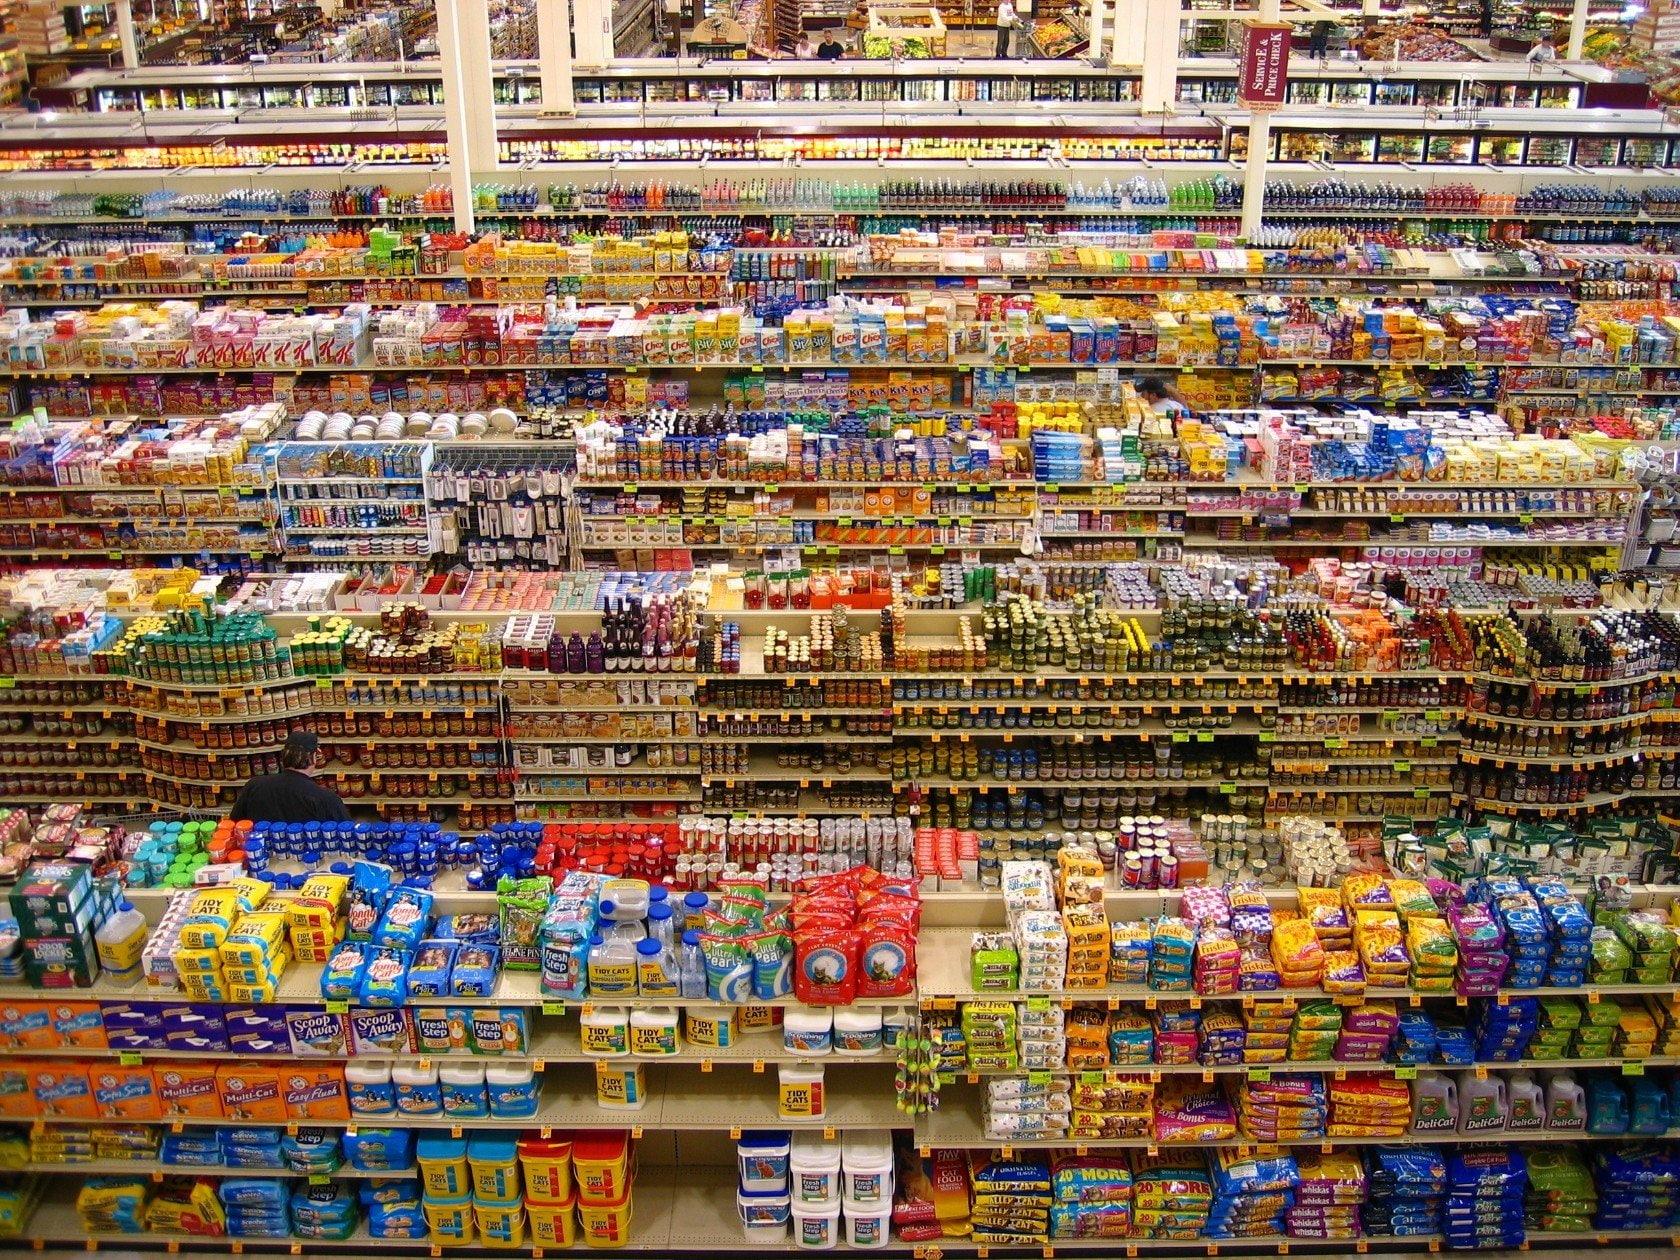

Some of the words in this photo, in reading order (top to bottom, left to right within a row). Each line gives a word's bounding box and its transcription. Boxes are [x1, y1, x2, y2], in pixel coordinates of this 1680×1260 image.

[1270, 32, 1282, 65] CHECK
[1252, 49, 1267, 90] SERVICE
[1265, 67, 1278, 96] PRICE
[740, 333, 757, 345] Chex
[762, 334, 779, 344] Chex
[837, 331, 856, 342] Chex
[862, 331, 882, 344] Chex
[645, 341, 664, 352] Chex
[671, 340, 690, 352] Chex
[191, 906, 220, 914] CATS
[1114, 930, 1149, 939] Friskies
[1156, 927, 1192, 937] Friskies
[527, 947, 543, 958] PIN
[1201, 943, 1235, 954] Friskies
[545, 951, 568, 962] Fresh
[705, 954, 743, 967] Pearls
[370, 963, 403, 972] Jonny
[545, 960, 567, 973] Step
[374, 970, 394, 978] Cat
[294, 1016, 331, 1033] Scoop
[358, 1012, 394, 1031] Scoop
[421, 1020, 447, 1029] Fresh
[475, 1021, 500, 1030] Fresh
[692, 1020, 713, 1029] TIDY
[305, 1023, 340, 1040] Away
[368, 1020, 403, 1038] Away
[423, 1028, 448, 1038] Step
[477, 1029, 500, 1039] Step
[588, 1027, 609, 1035] TIDY
[637, 1029, 659, 1037] TIDY
[692, 1027, 713, 1036] CATS
[637, 1036, 660, 1044] CATS
[601, 1077, 621, 1085] TIDY
[163, 1084, 211, 1098] Multi-Cat
[226, 1089, 274, 1103] Multi-Cat
[288, 1091, 309, 1103] Easy
[311, 1087, 338, 1100] Flush
[1177, 1112, 1206, 1123] Bonus
[938, 1151, 959, 1160] FMV
[1082, 1169, 1129, 1181] MORE
[1161, 1181, 1210, 1195] MORE
[1302, 1186, 1330, 1194] whiskas
[1292, 1209, 1319, 1217] whiskas
